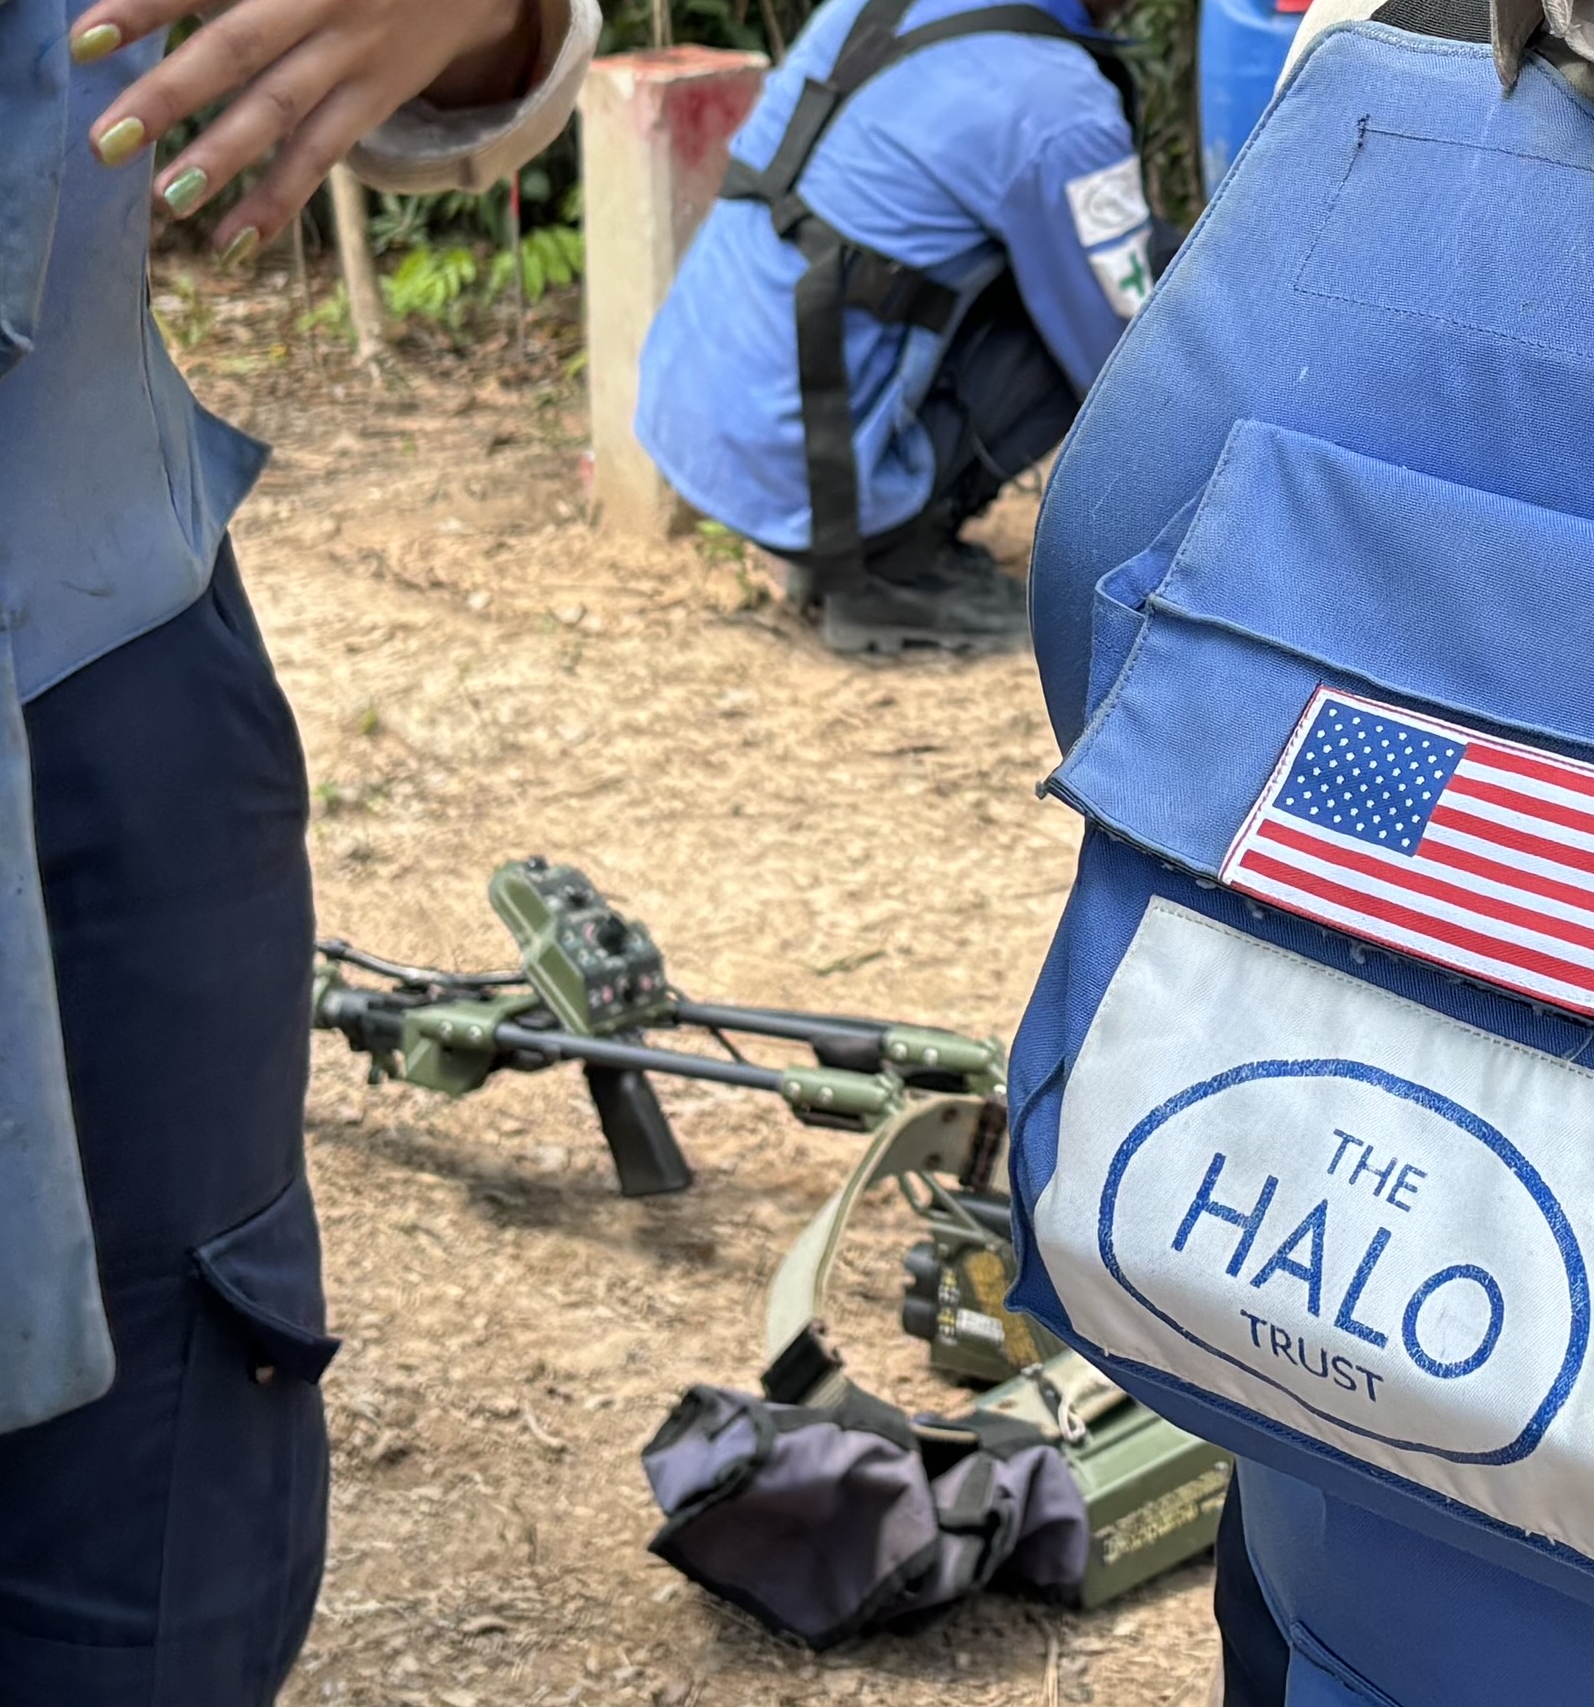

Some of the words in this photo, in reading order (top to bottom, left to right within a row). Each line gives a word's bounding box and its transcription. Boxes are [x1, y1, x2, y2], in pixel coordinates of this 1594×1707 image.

[1325, 1128, 1428, 1212] THE
[1171, 1151, 1505, 1380] HALO
[1240, 1308, 1384, 1404] TRUST
